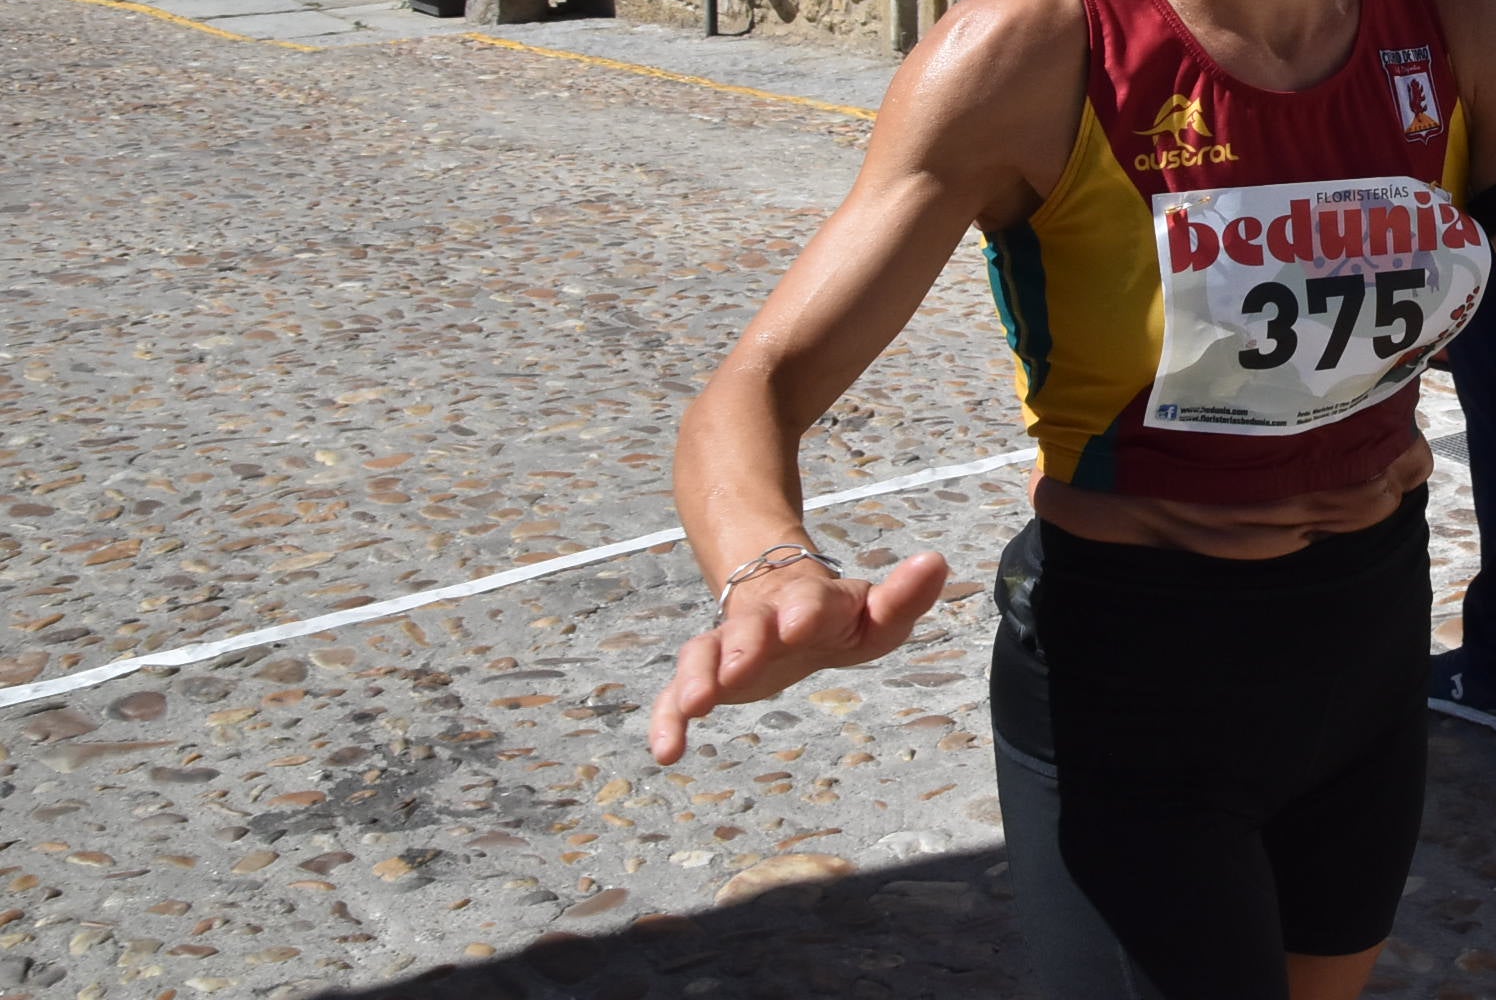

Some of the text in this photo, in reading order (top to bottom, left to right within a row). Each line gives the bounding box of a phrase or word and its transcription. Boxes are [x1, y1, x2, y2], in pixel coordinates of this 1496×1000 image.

[1134, 143, 1240, 171] austral
[1316, 183, 1410, 205] FLORISTERÍAS
[1165, 190, 1482, 273] bedunia
[1238, 268, 1426, 371] 375
